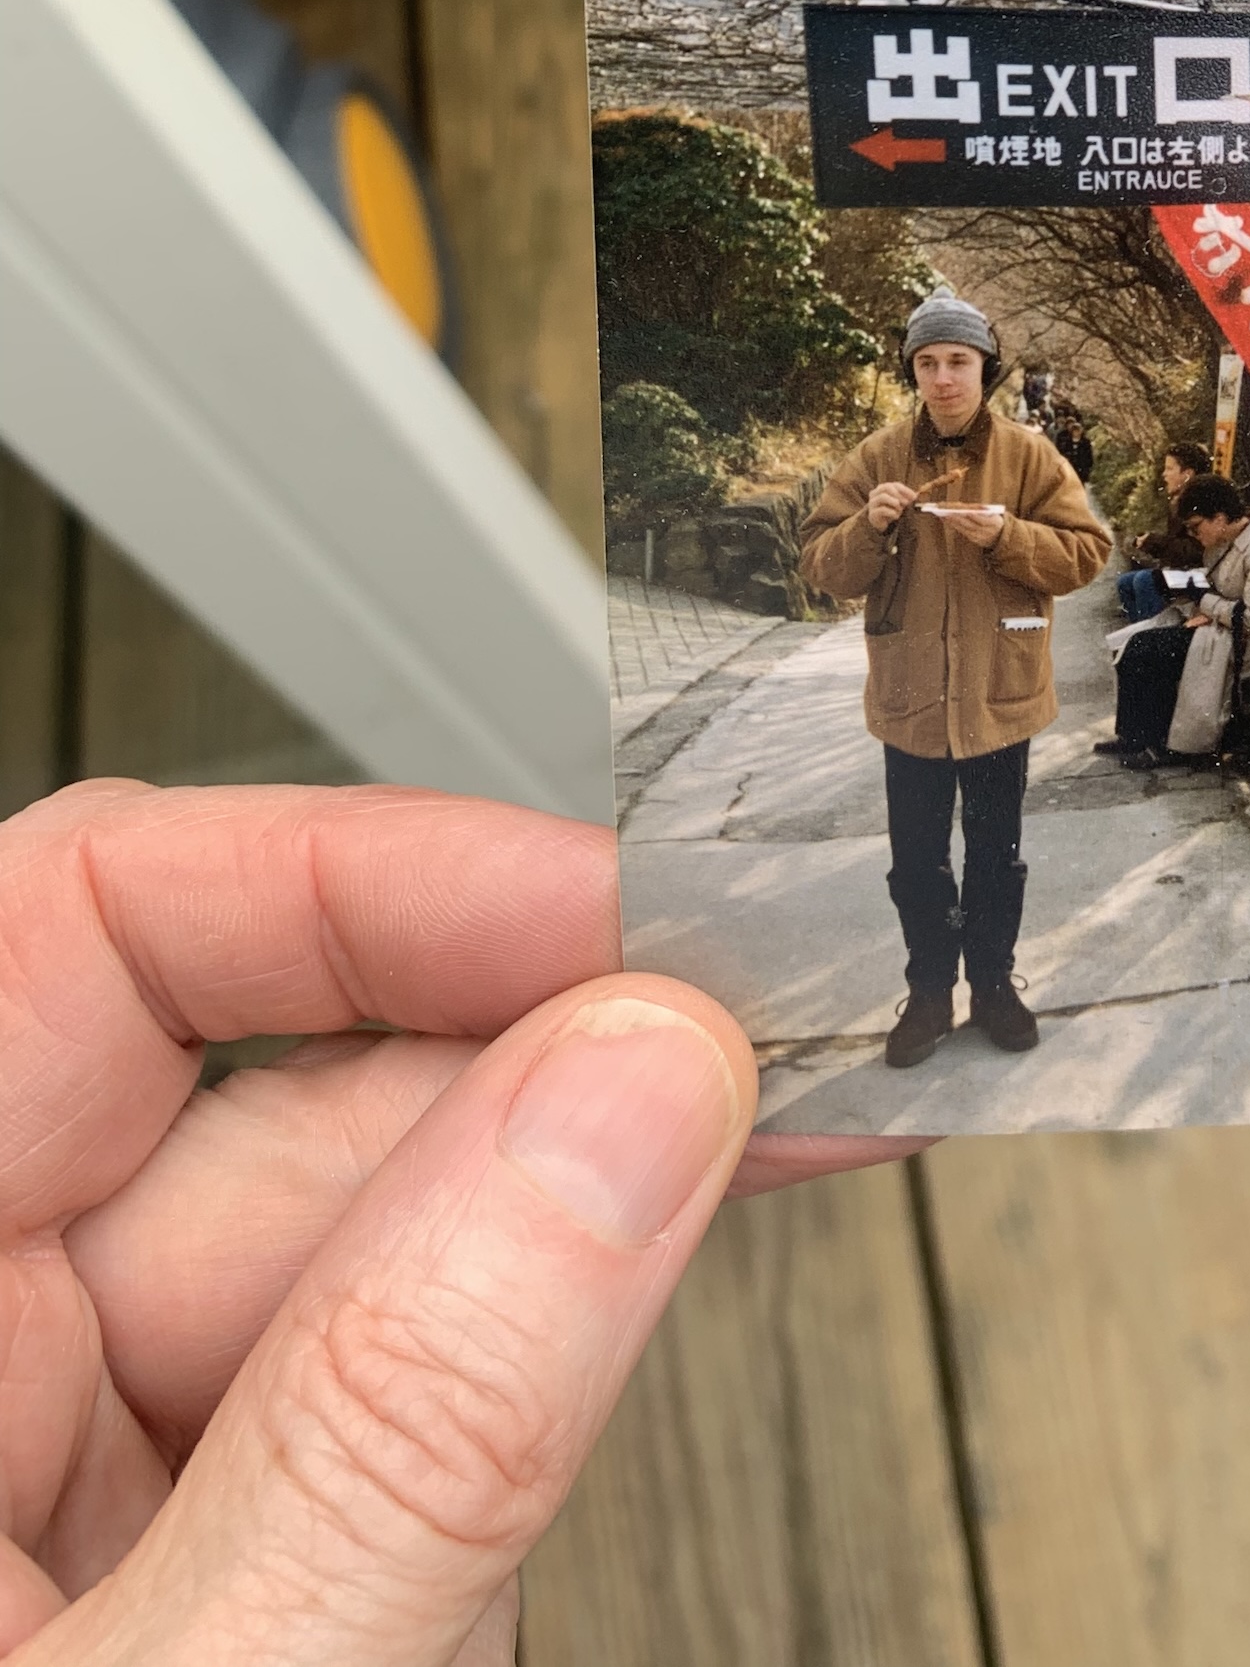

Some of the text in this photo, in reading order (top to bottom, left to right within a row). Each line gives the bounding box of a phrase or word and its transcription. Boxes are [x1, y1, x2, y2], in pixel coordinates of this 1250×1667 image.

[867, 28, 982, 123] 出
[997, 64, 1138, 118] EXIT
[965, 135, 1062, 166] 噴煙地
[1078, 169, 1203, 191] ENTRAUCE
